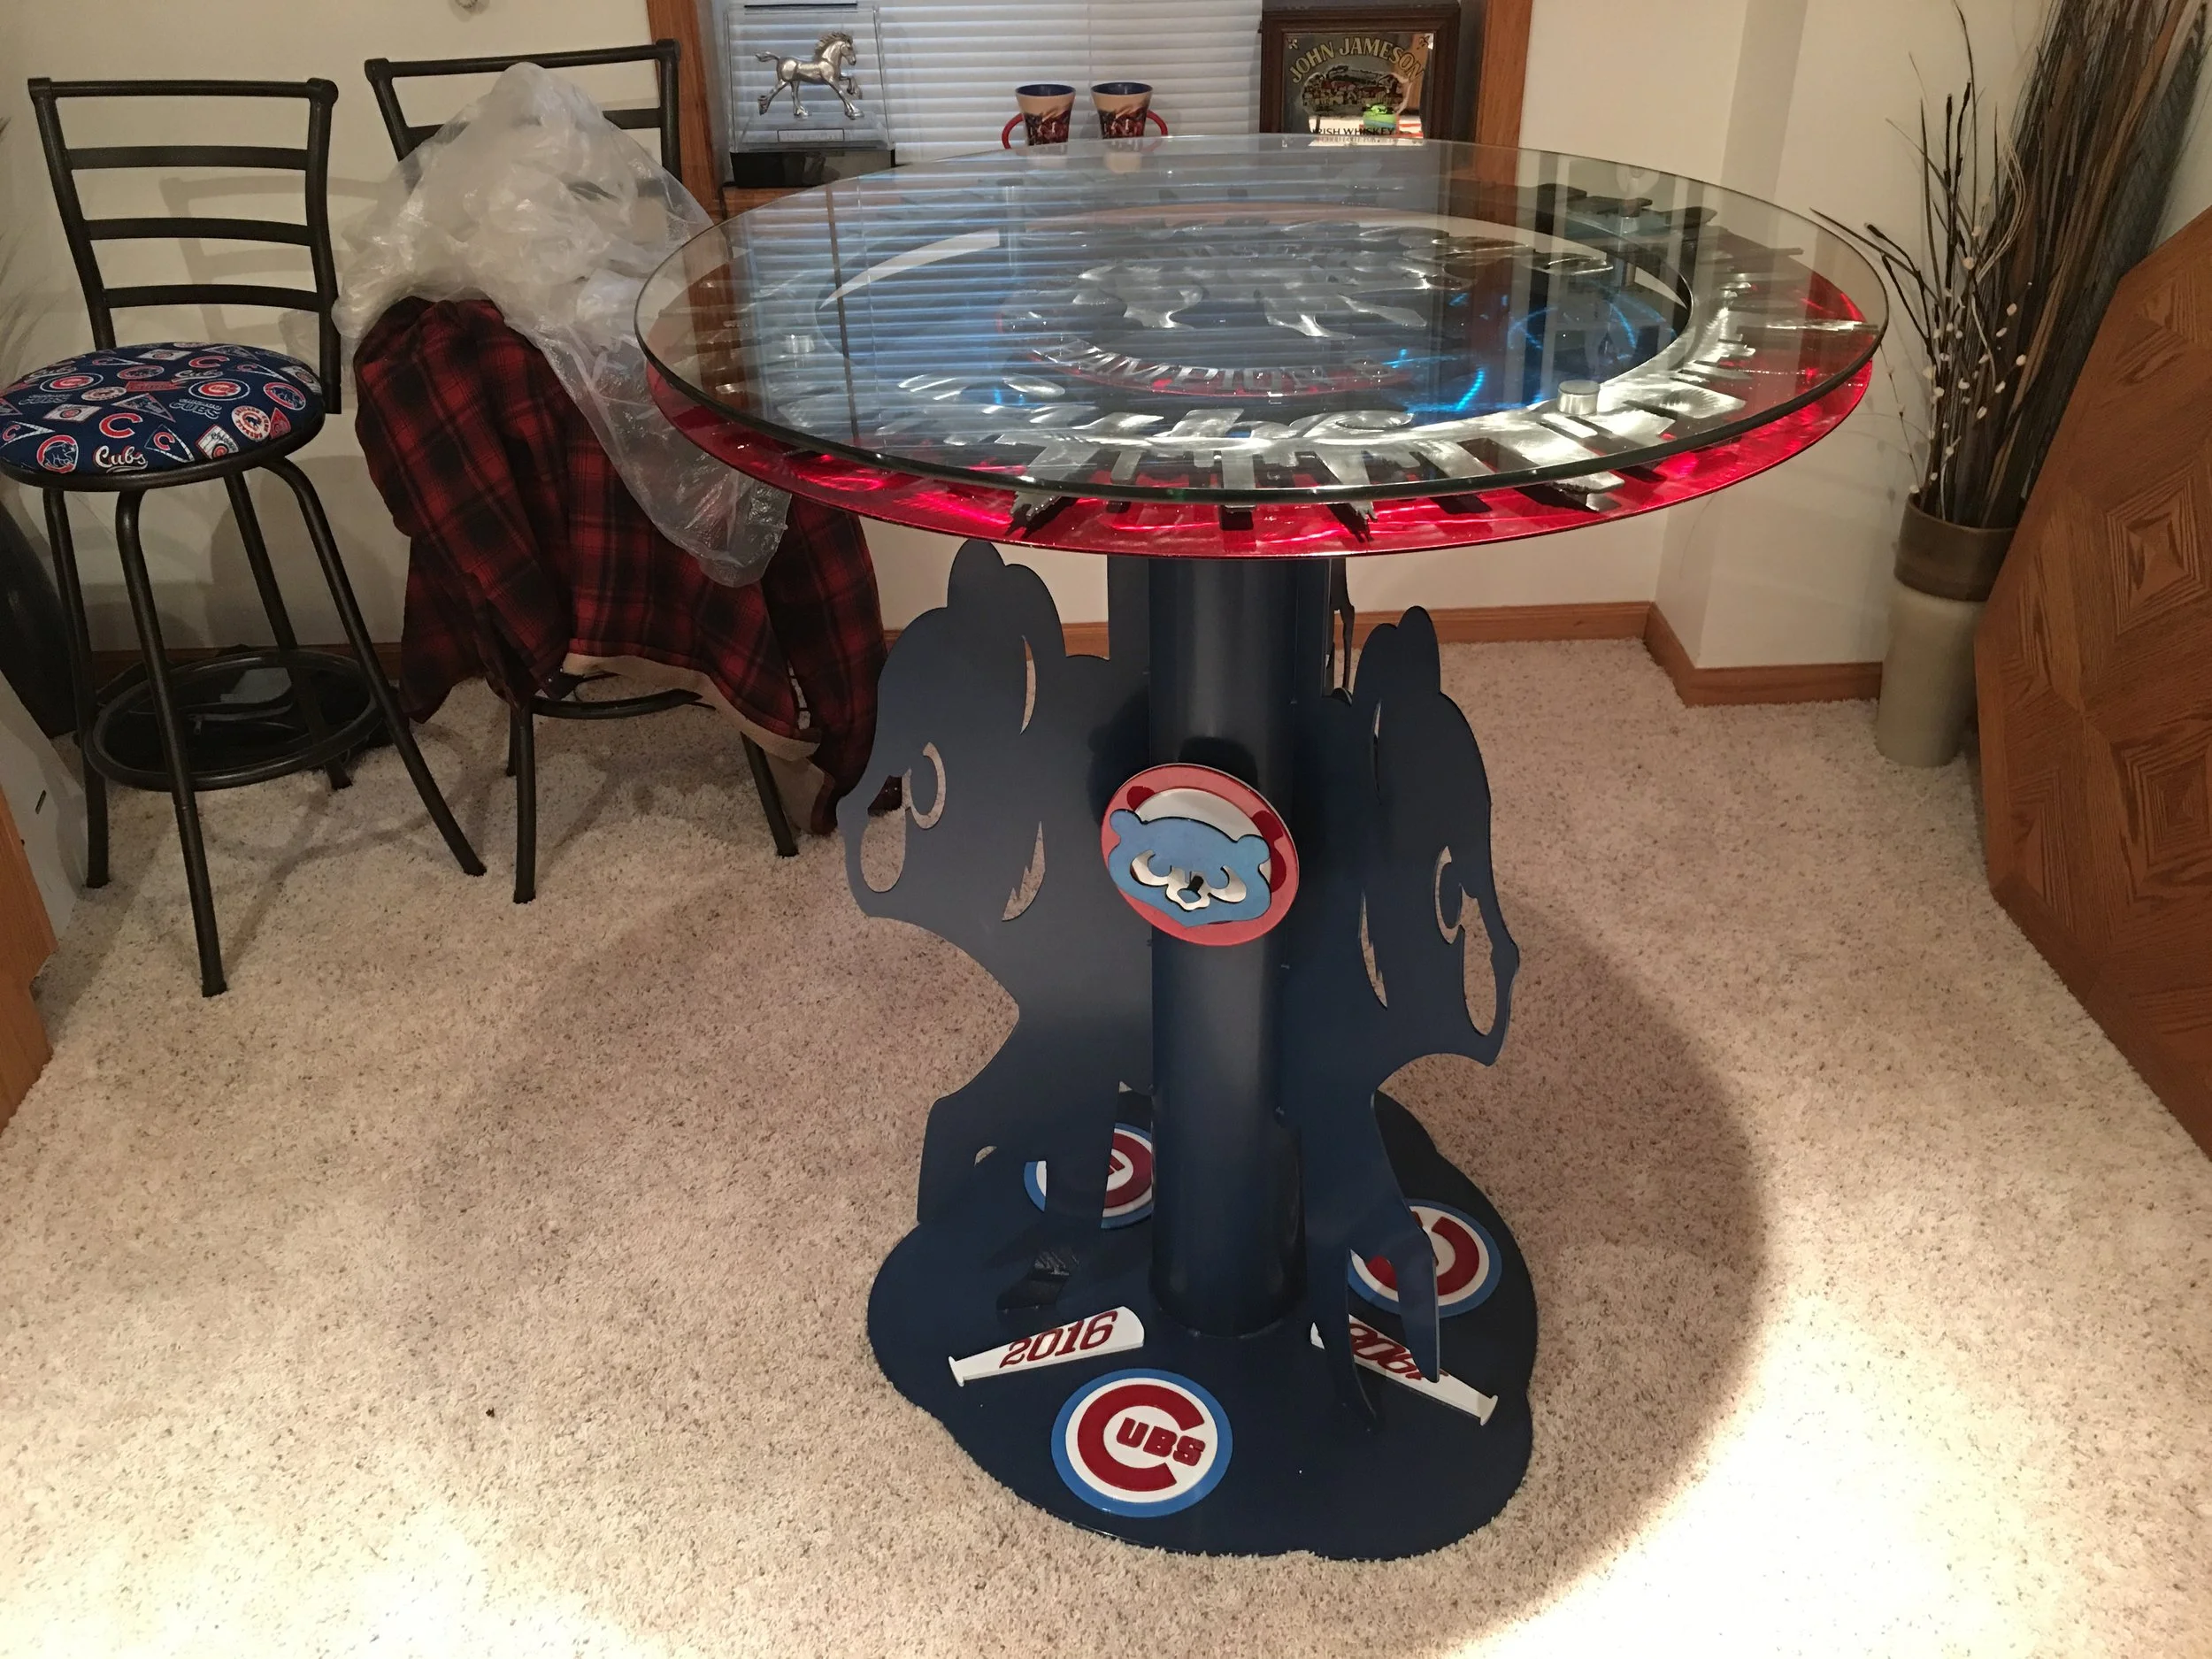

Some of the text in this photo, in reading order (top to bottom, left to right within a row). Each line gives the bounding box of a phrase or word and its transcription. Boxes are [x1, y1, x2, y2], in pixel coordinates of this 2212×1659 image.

[1289, 37, 1424, 82] JOHN JAMESON
[99, 412, 143, 439] C
[153, 431, 175, 451] C
[93, 445, 148, 473] Cubs
[999, 1310, 1118, 1369] 2016
[1077, 1384, 1206, 1492] CUBS
